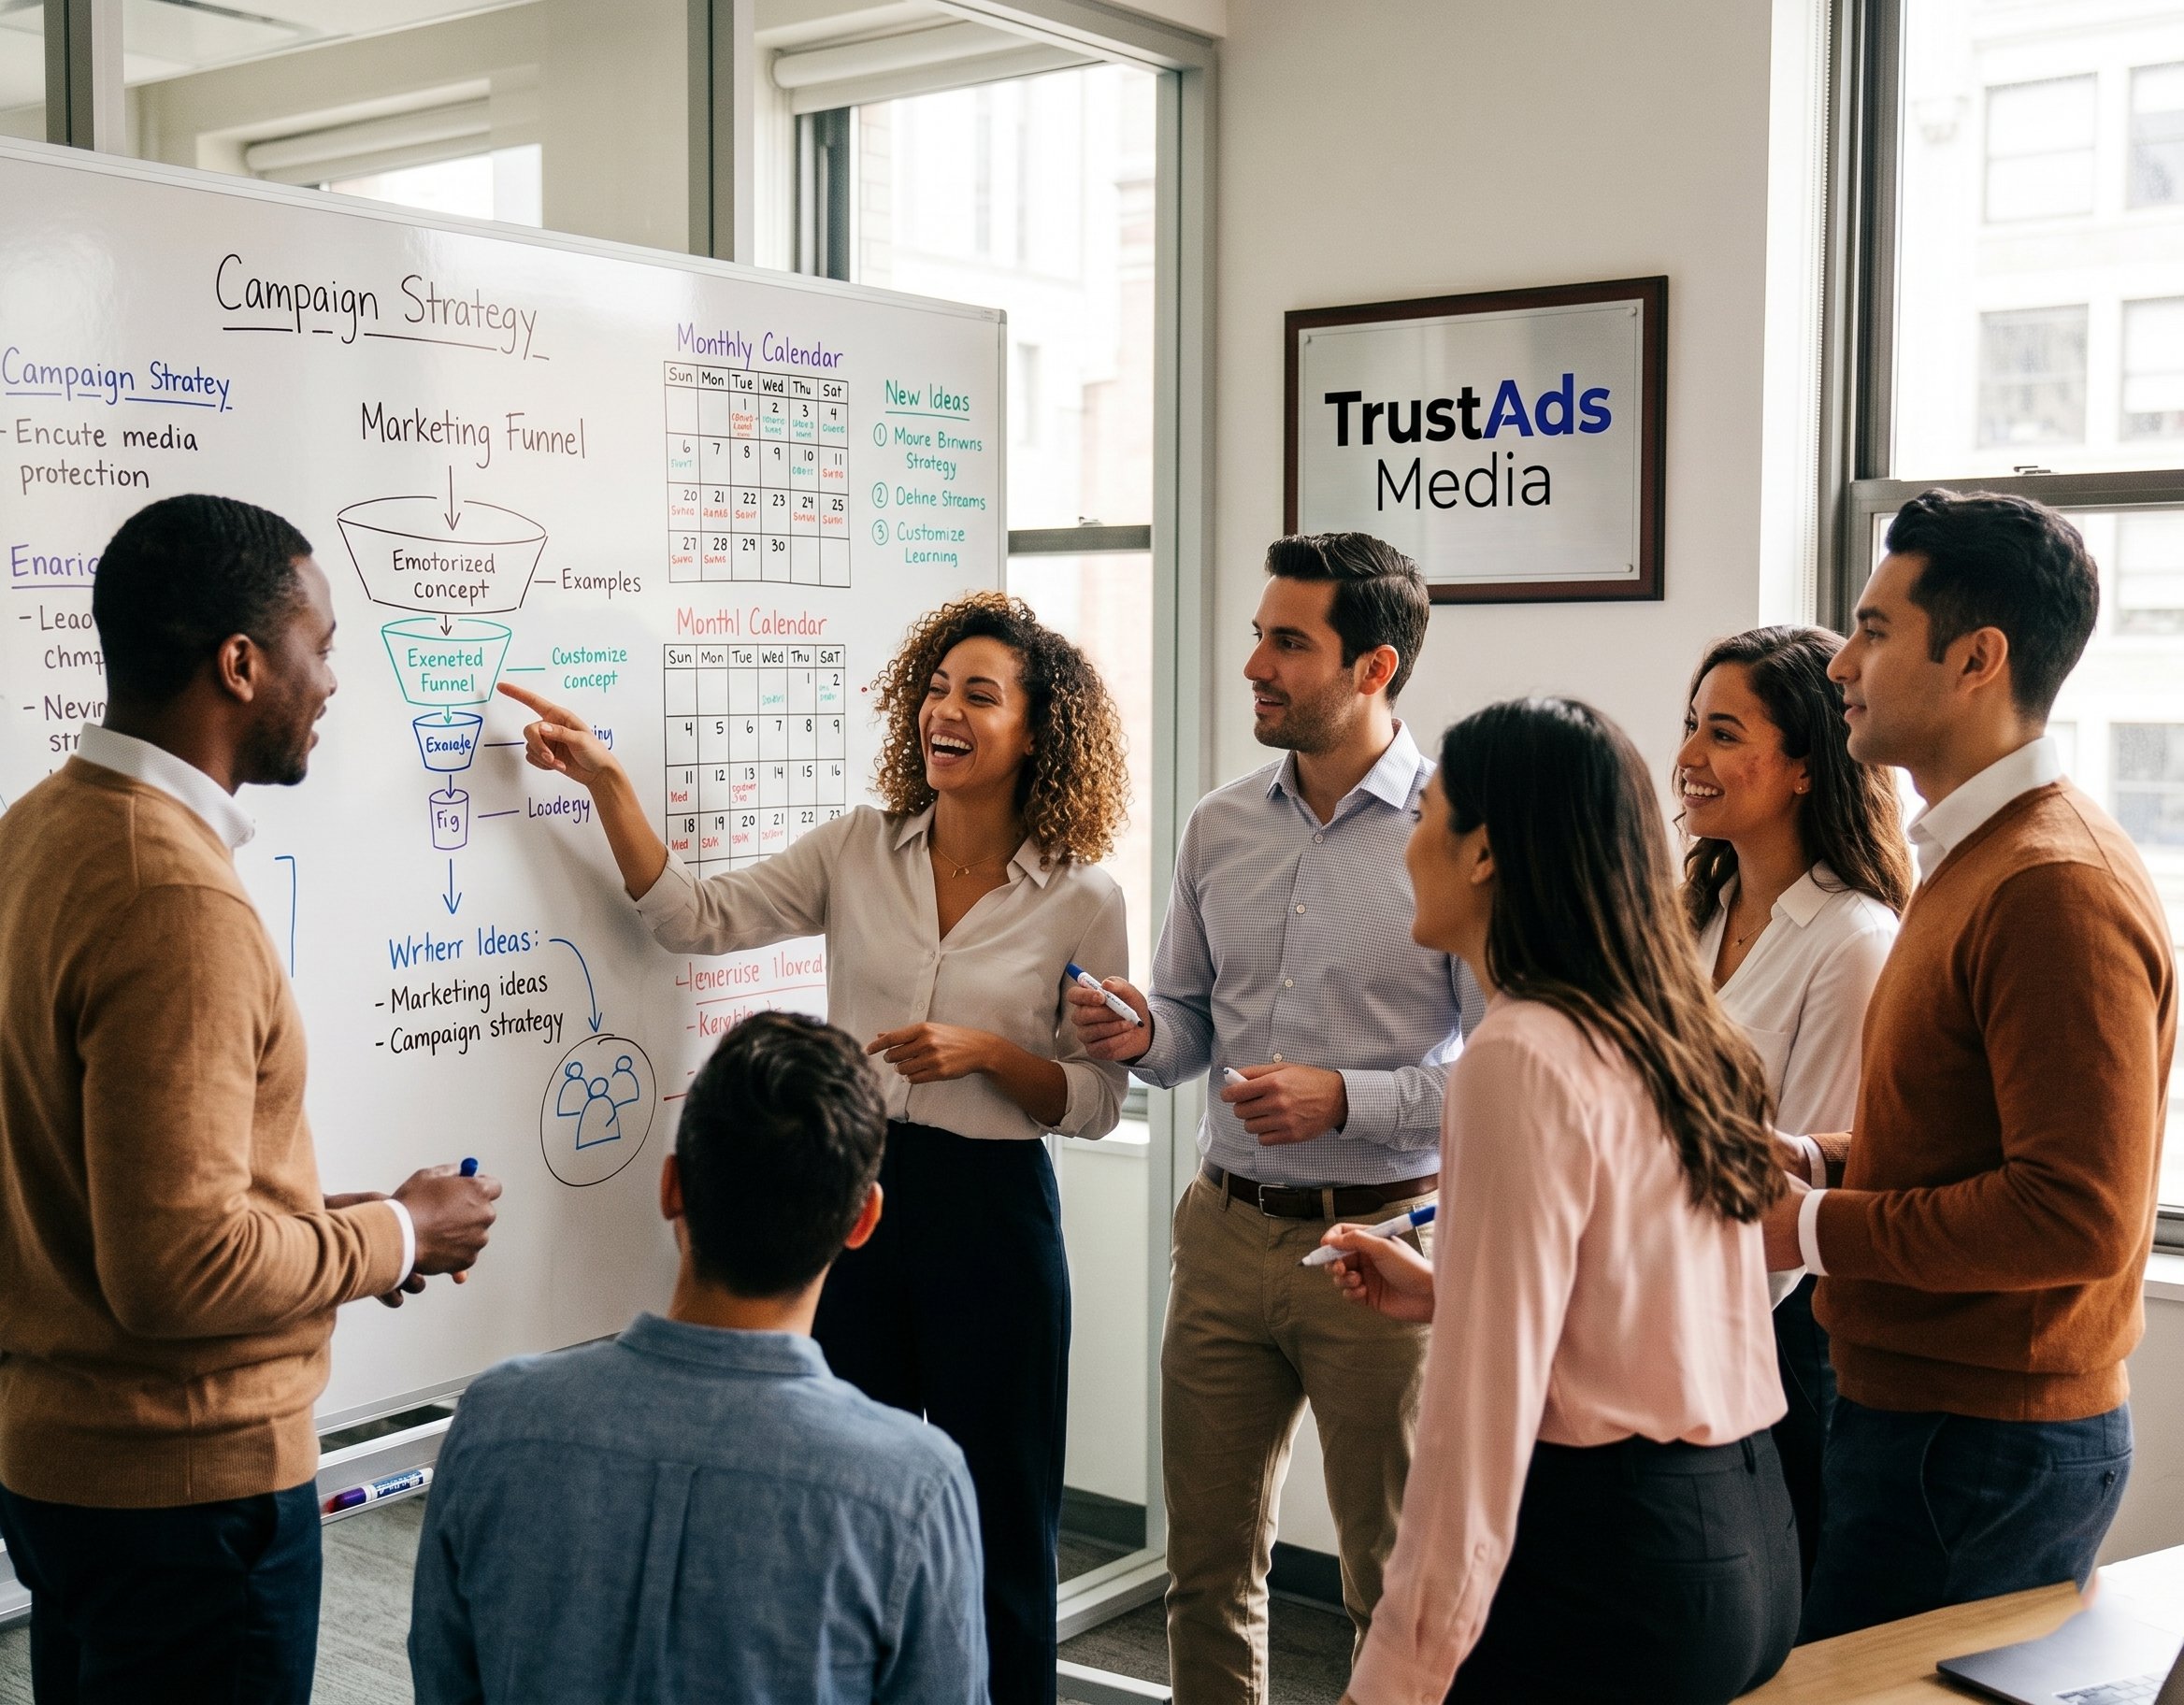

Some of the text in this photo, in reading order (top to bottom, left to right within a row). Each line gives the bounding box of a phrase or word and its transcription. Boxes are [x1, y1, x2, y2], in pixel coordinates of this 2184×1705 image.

[215, 254, 537, 361] Campaign Strategy
[677, 322, 843, 371] Monthly Calendar
[1, 347, 231, 412] Campaign Stratey
[668, 366, 841, 397] Sun Mon Tue Wed Thu Sat
[885, 380, 970, 411] New Ideas
[772, 403, 779, 413] 2
[801, 405, 809, 417] 3
[830, 408, 837, 421] 4
[1324, 372, 1612, 447] TrustAds
[16, 418, 198, 452] Encute media
[362, 402, 585, 468] Marketing Funnel
[682, 439, 842, 466] 6 7 8 9 10 11
[906, 452, 956, 480] Strategy
[21, 461, 150, 495] protection
[1377, 451, 1551, 511] Media
[684, 490, 843, 511] 20 21 22 23 24 25
[683, 537, 784, 552] 27 28 29 30
[898, 522, 965, 542] Customize
[393, 549, 496, 573] Emotorized
[905, 547, 958, 567] Learning
[414, 579, 490, 607] concept
[562, 567, 641, 600] Examples
[750, 607, 827, 636] Calendar
[408, 647, 483, 667] Exeneted
[553, 647, 628, 665] Customize
[668, 652, 692, 664] Sun
[701, 652, 724, 664] Mon
[732, 651, 753, 664] Tue
[762, 650, 783, 664] Wed
[791, 650, 810, 663] Thu
[421, 673, 475, 693] Funnel
[564, 670, 618, 694] concept
[833, 674, 841, 686] 2
[685, 719, 840, 737] 4 5 6 7 8 9
[685, 765, 841, 783] 11 12 13 14 15 16
[437, 810, 460, 832] Fig
[684, 810, 841, 833] 18 19 20 21 22 23
[478, 925, 539, 967] Ideas:
[391, 971, 548, 1014] Marketing ideas
[390, 1010, 564, 1056] Campaign strategy
